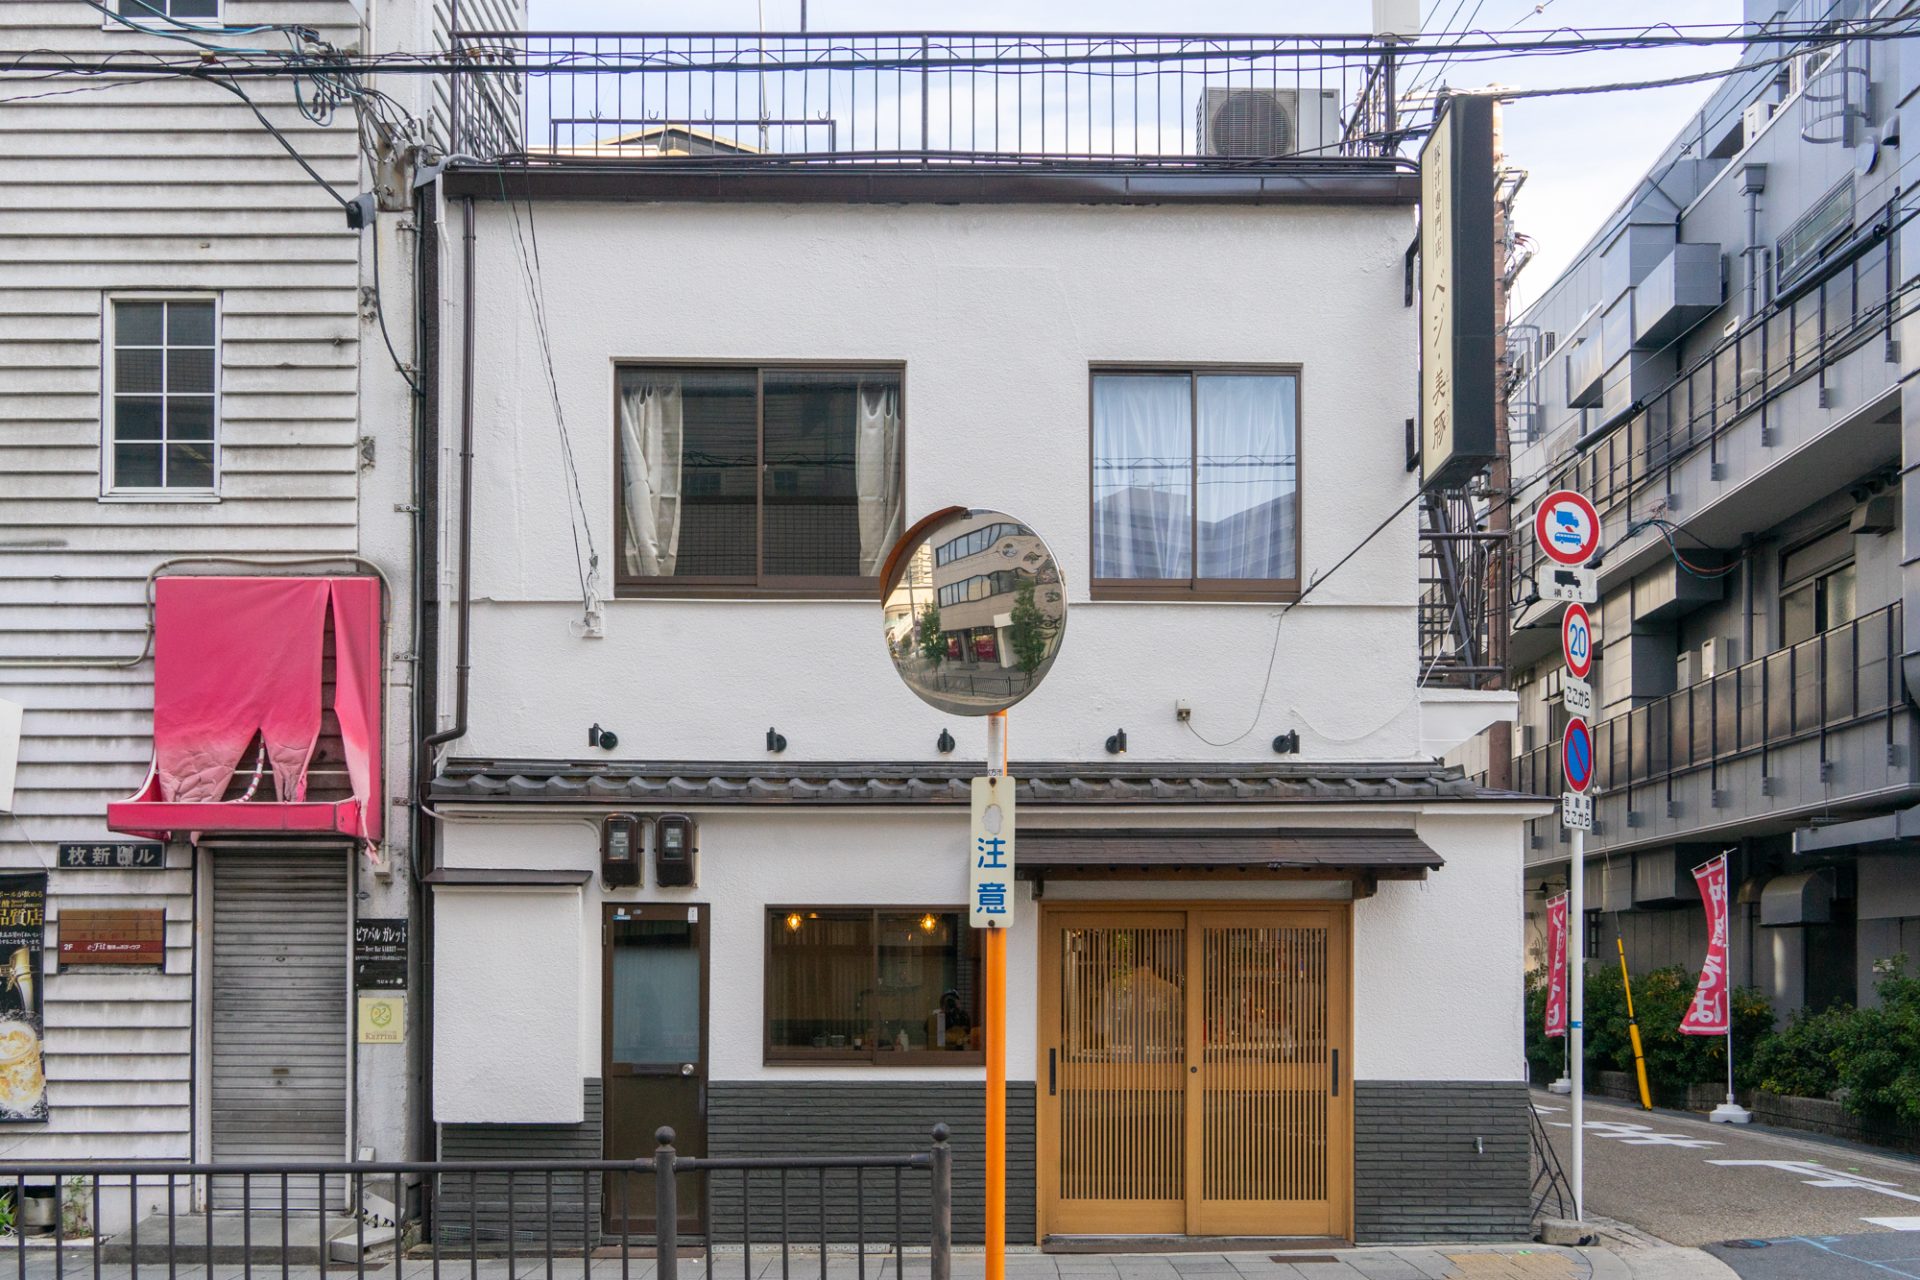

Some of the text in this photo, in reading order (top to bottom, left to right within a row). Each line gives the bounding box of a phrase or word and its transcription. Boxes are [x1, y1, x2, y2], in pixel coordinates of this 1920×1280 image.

[1432, 268, 1447, 451] ベジ・美豚
[1570, 623, 1587, 658] 20
[1566, 686, 1590, 709] ここから
[1565, 796, 1590, 810] 自動車
[1565, 810, 1591, 827] ここから
[976, 837, 1007, 914] 注意
[382, 927, 407, 943] ガレット
[64, 943, 74, 951] 2F
